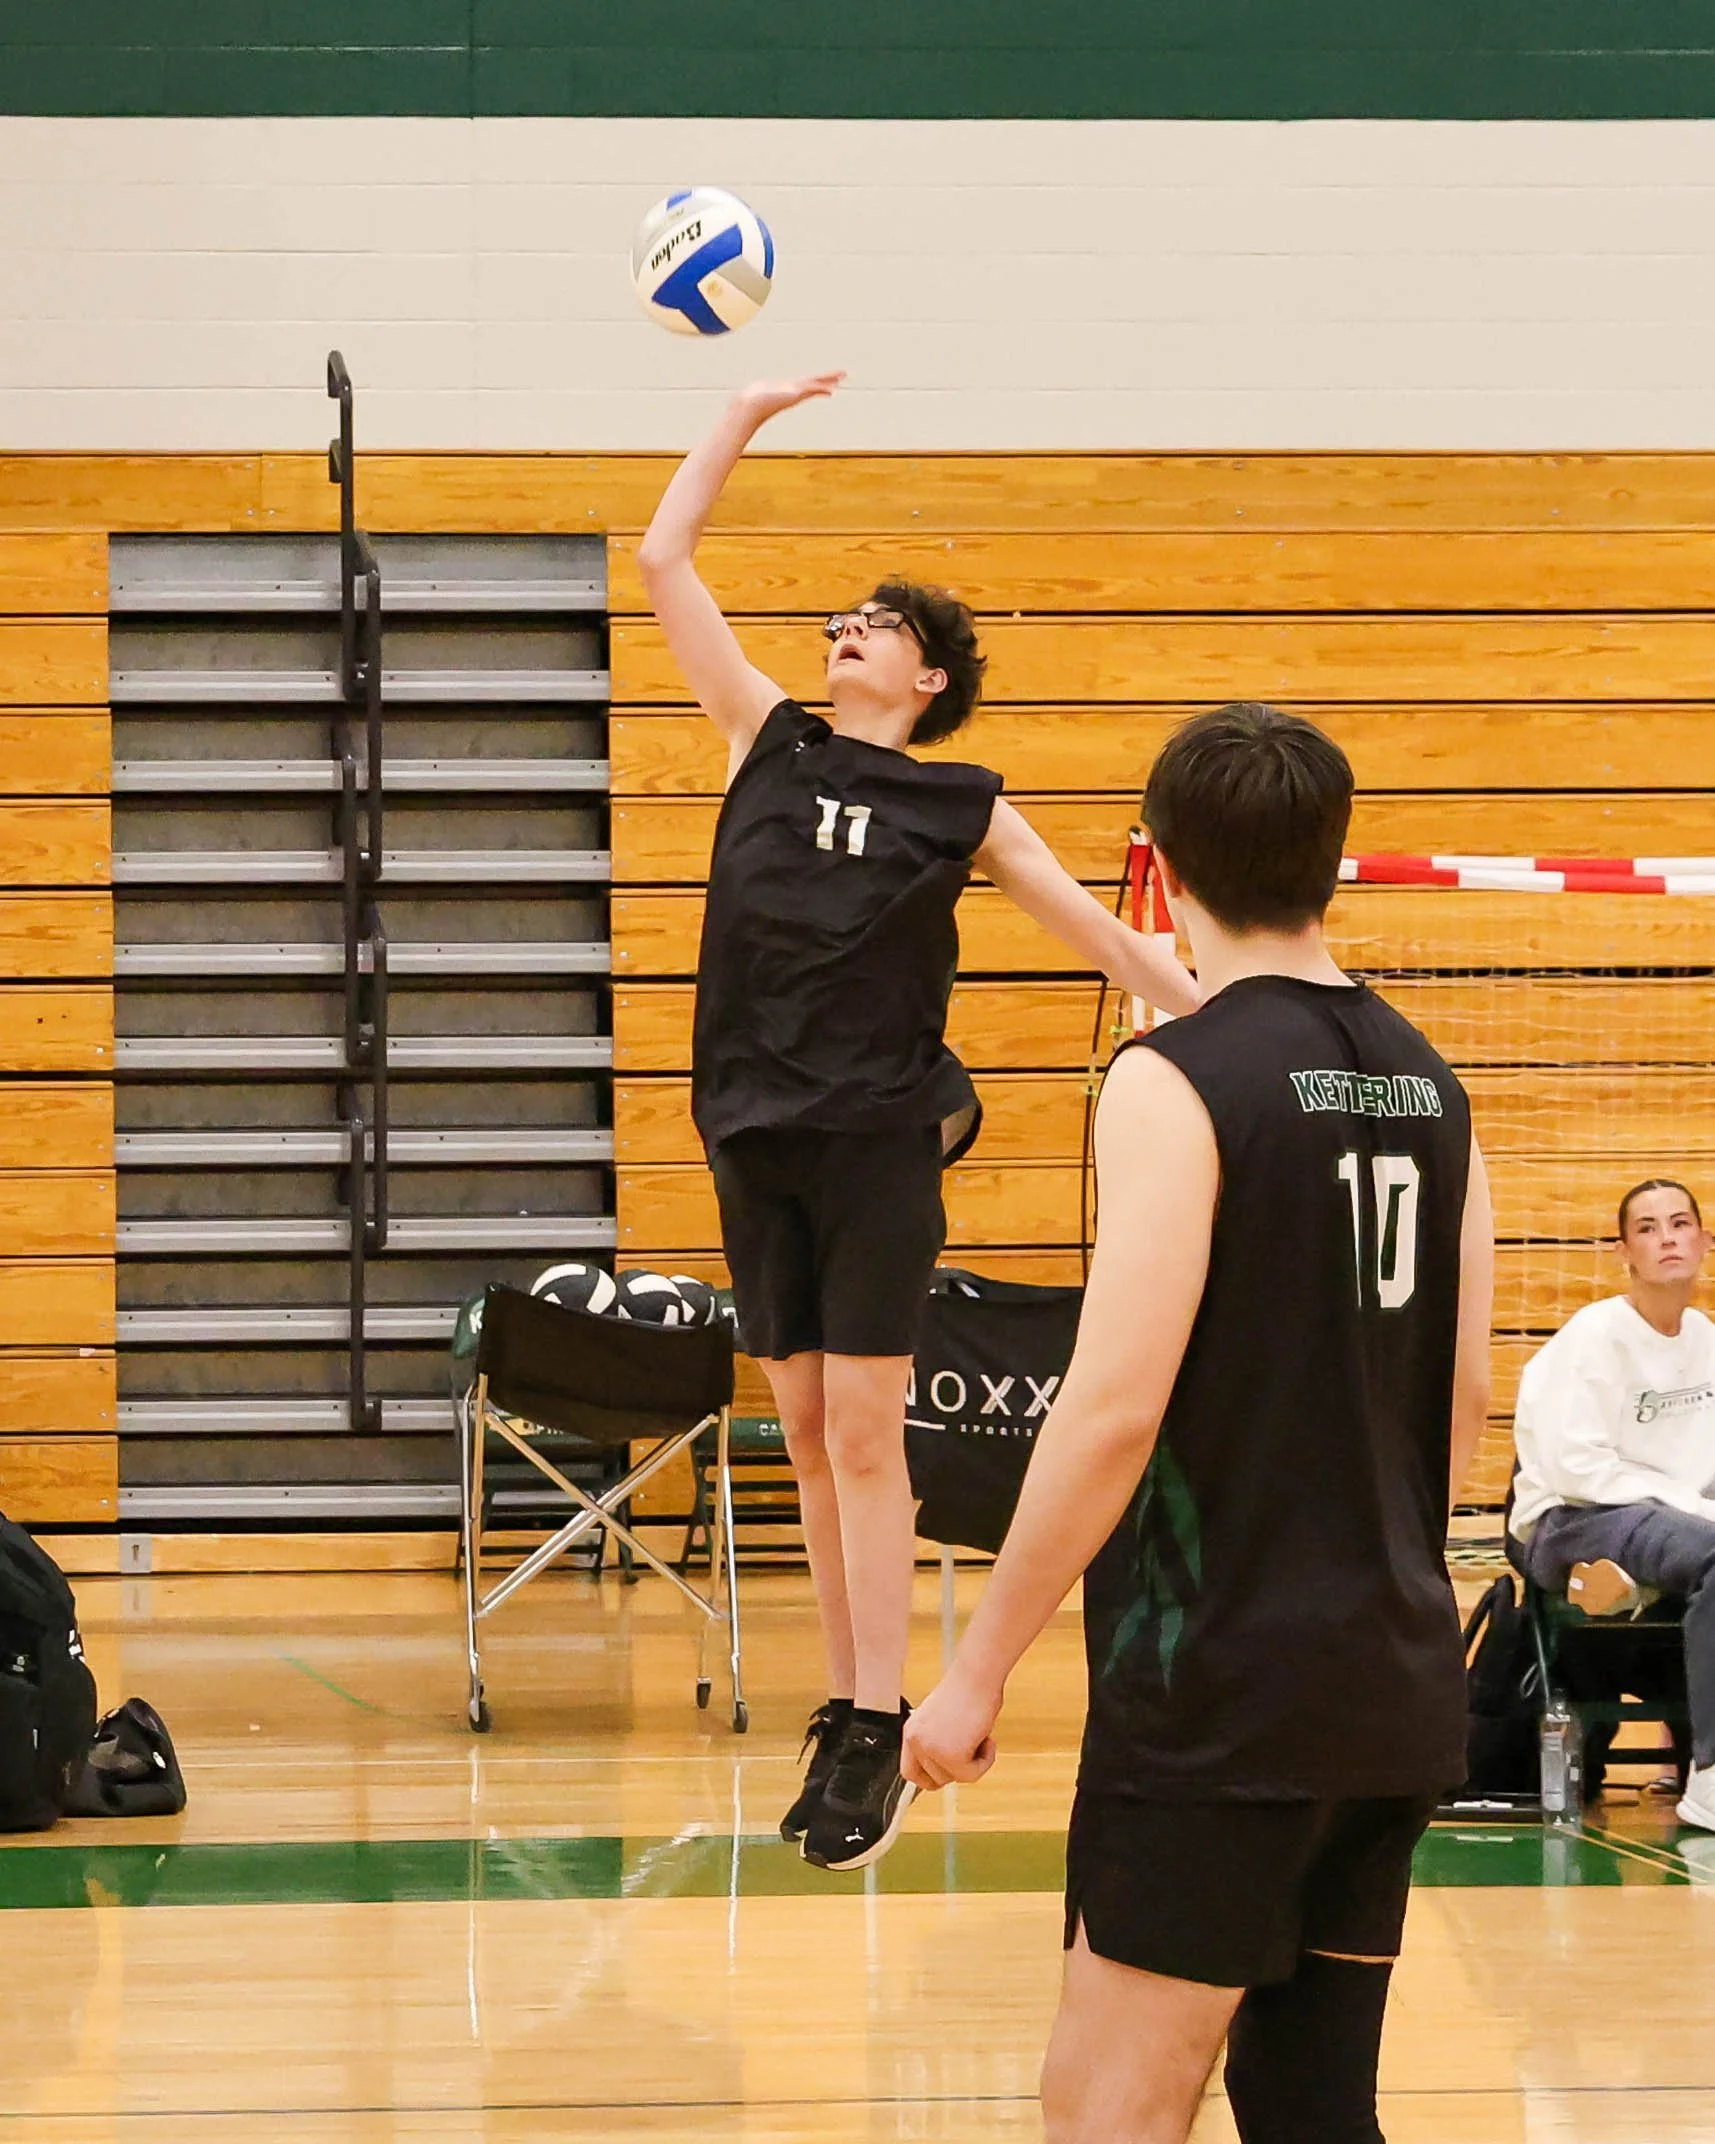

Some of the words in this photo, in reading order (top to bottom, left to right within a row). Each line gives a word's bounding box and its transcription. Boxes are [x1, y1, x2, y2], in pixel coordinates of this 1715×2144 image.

[815, 795, 873, 856] 11
[1289, 1069, 1443, 1118] KETTERING
[1338, 1151, 1421, 1309] 10
[960, 1423, 1033, 1438] SPORTS
